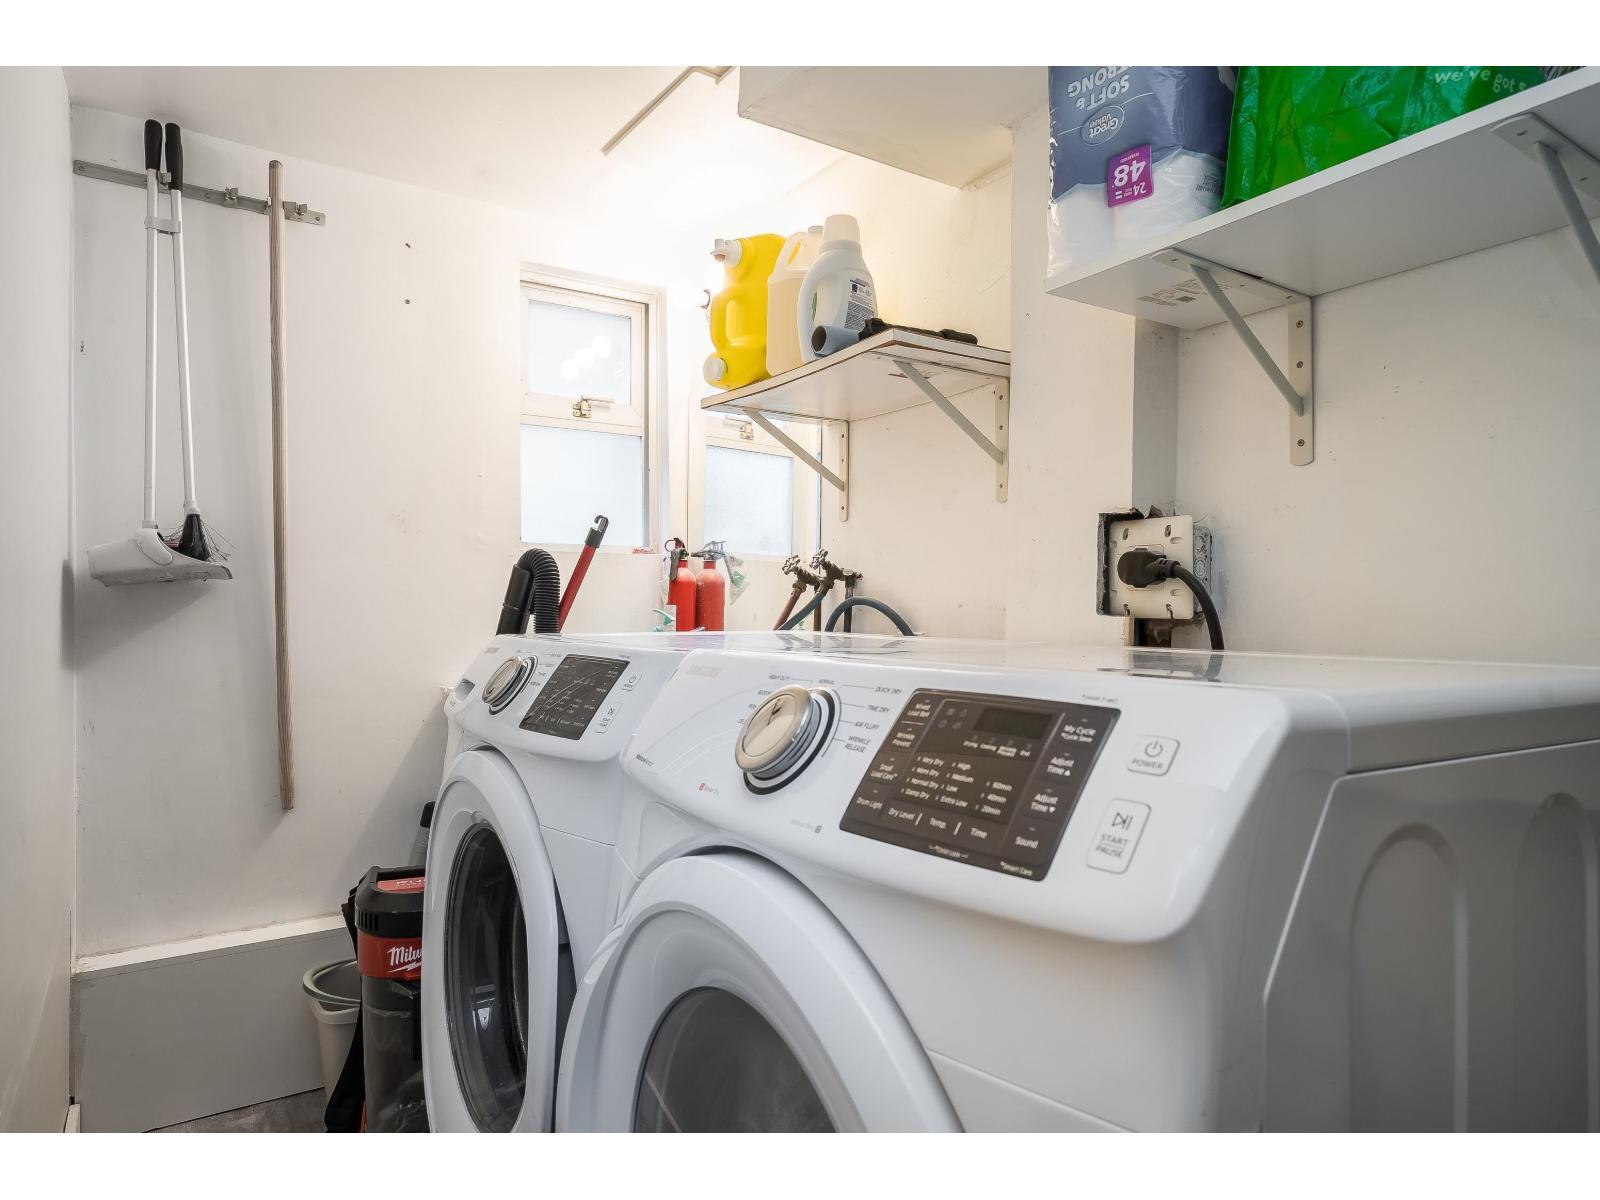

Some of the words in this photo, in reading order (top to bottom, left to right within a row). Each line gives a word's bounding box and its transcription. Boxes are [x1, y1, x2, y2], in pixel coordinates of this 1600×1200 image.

[1068, 66, 1132, 97] TRONG
[1087, 74, 1130, 111] SOFT
[1088, 113, 1112, 128] Value
[1089, 117, 1118, 138] Great
[1114, 160, 1146, 187] 48
[1133, 182, 1147, 196] 24
[1064, 724, 1075, 734] My
[1076, 726, 1096, 736] Cycle
[934, 758, 944, 767] Dry
[1050, 757, 1074, 768] Adjust
[1132, 758, 1164, 770] POWER
[929, 770, 940, 778] Dry
[1047, 765, 1064, 774] Time
[912, 778, 928, 786] Normal
[929, 781, 939, 789] Dry
[952, 774, 974, 784] Medium
[920, 792, 930, 800] Dry
[940, 796, 955, 804] Extra
[956, 799, 968, 808] Low
[1034, 793, 1058, 804] Adjust
[1031, 801, 1048, 813] Time
[888, 808, 899, 816] Dry
[900, 811, 916, 820] Level
[970, 828, 988, 839] Time
[1016, 836, 1038, 848] Sound
[1102, 834, 1128, 846] START
[1096, 845, 1122, 858] PAUSE
